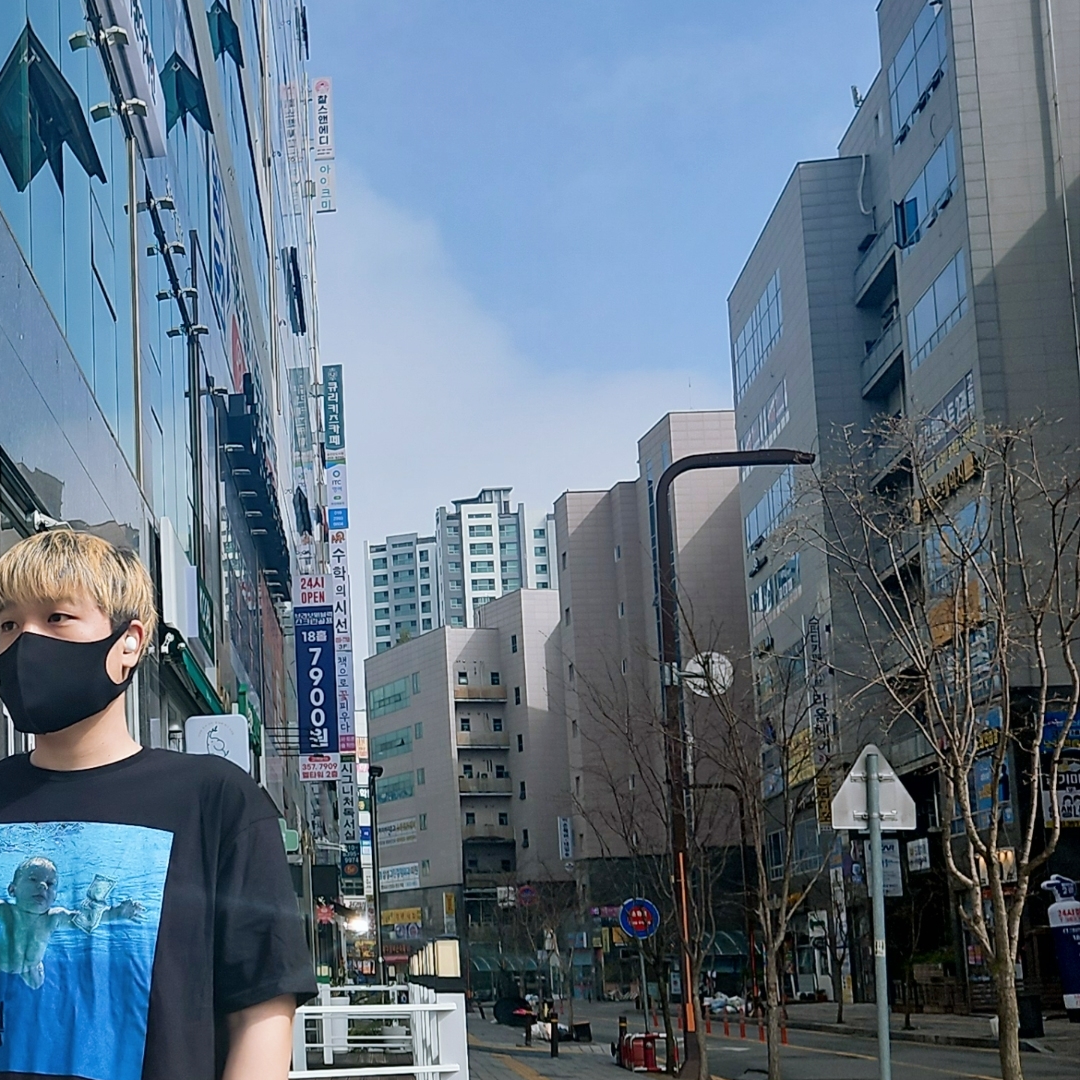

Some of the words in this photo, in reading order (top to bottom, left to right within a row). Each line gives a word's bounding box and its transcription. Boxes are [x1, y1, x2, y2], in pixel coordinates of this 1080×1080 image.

[327, 381, 341, 446] 큐리키즈카페
[300, 576, 325, 590] 24시
[301, 591, 325, 604] OPEN
